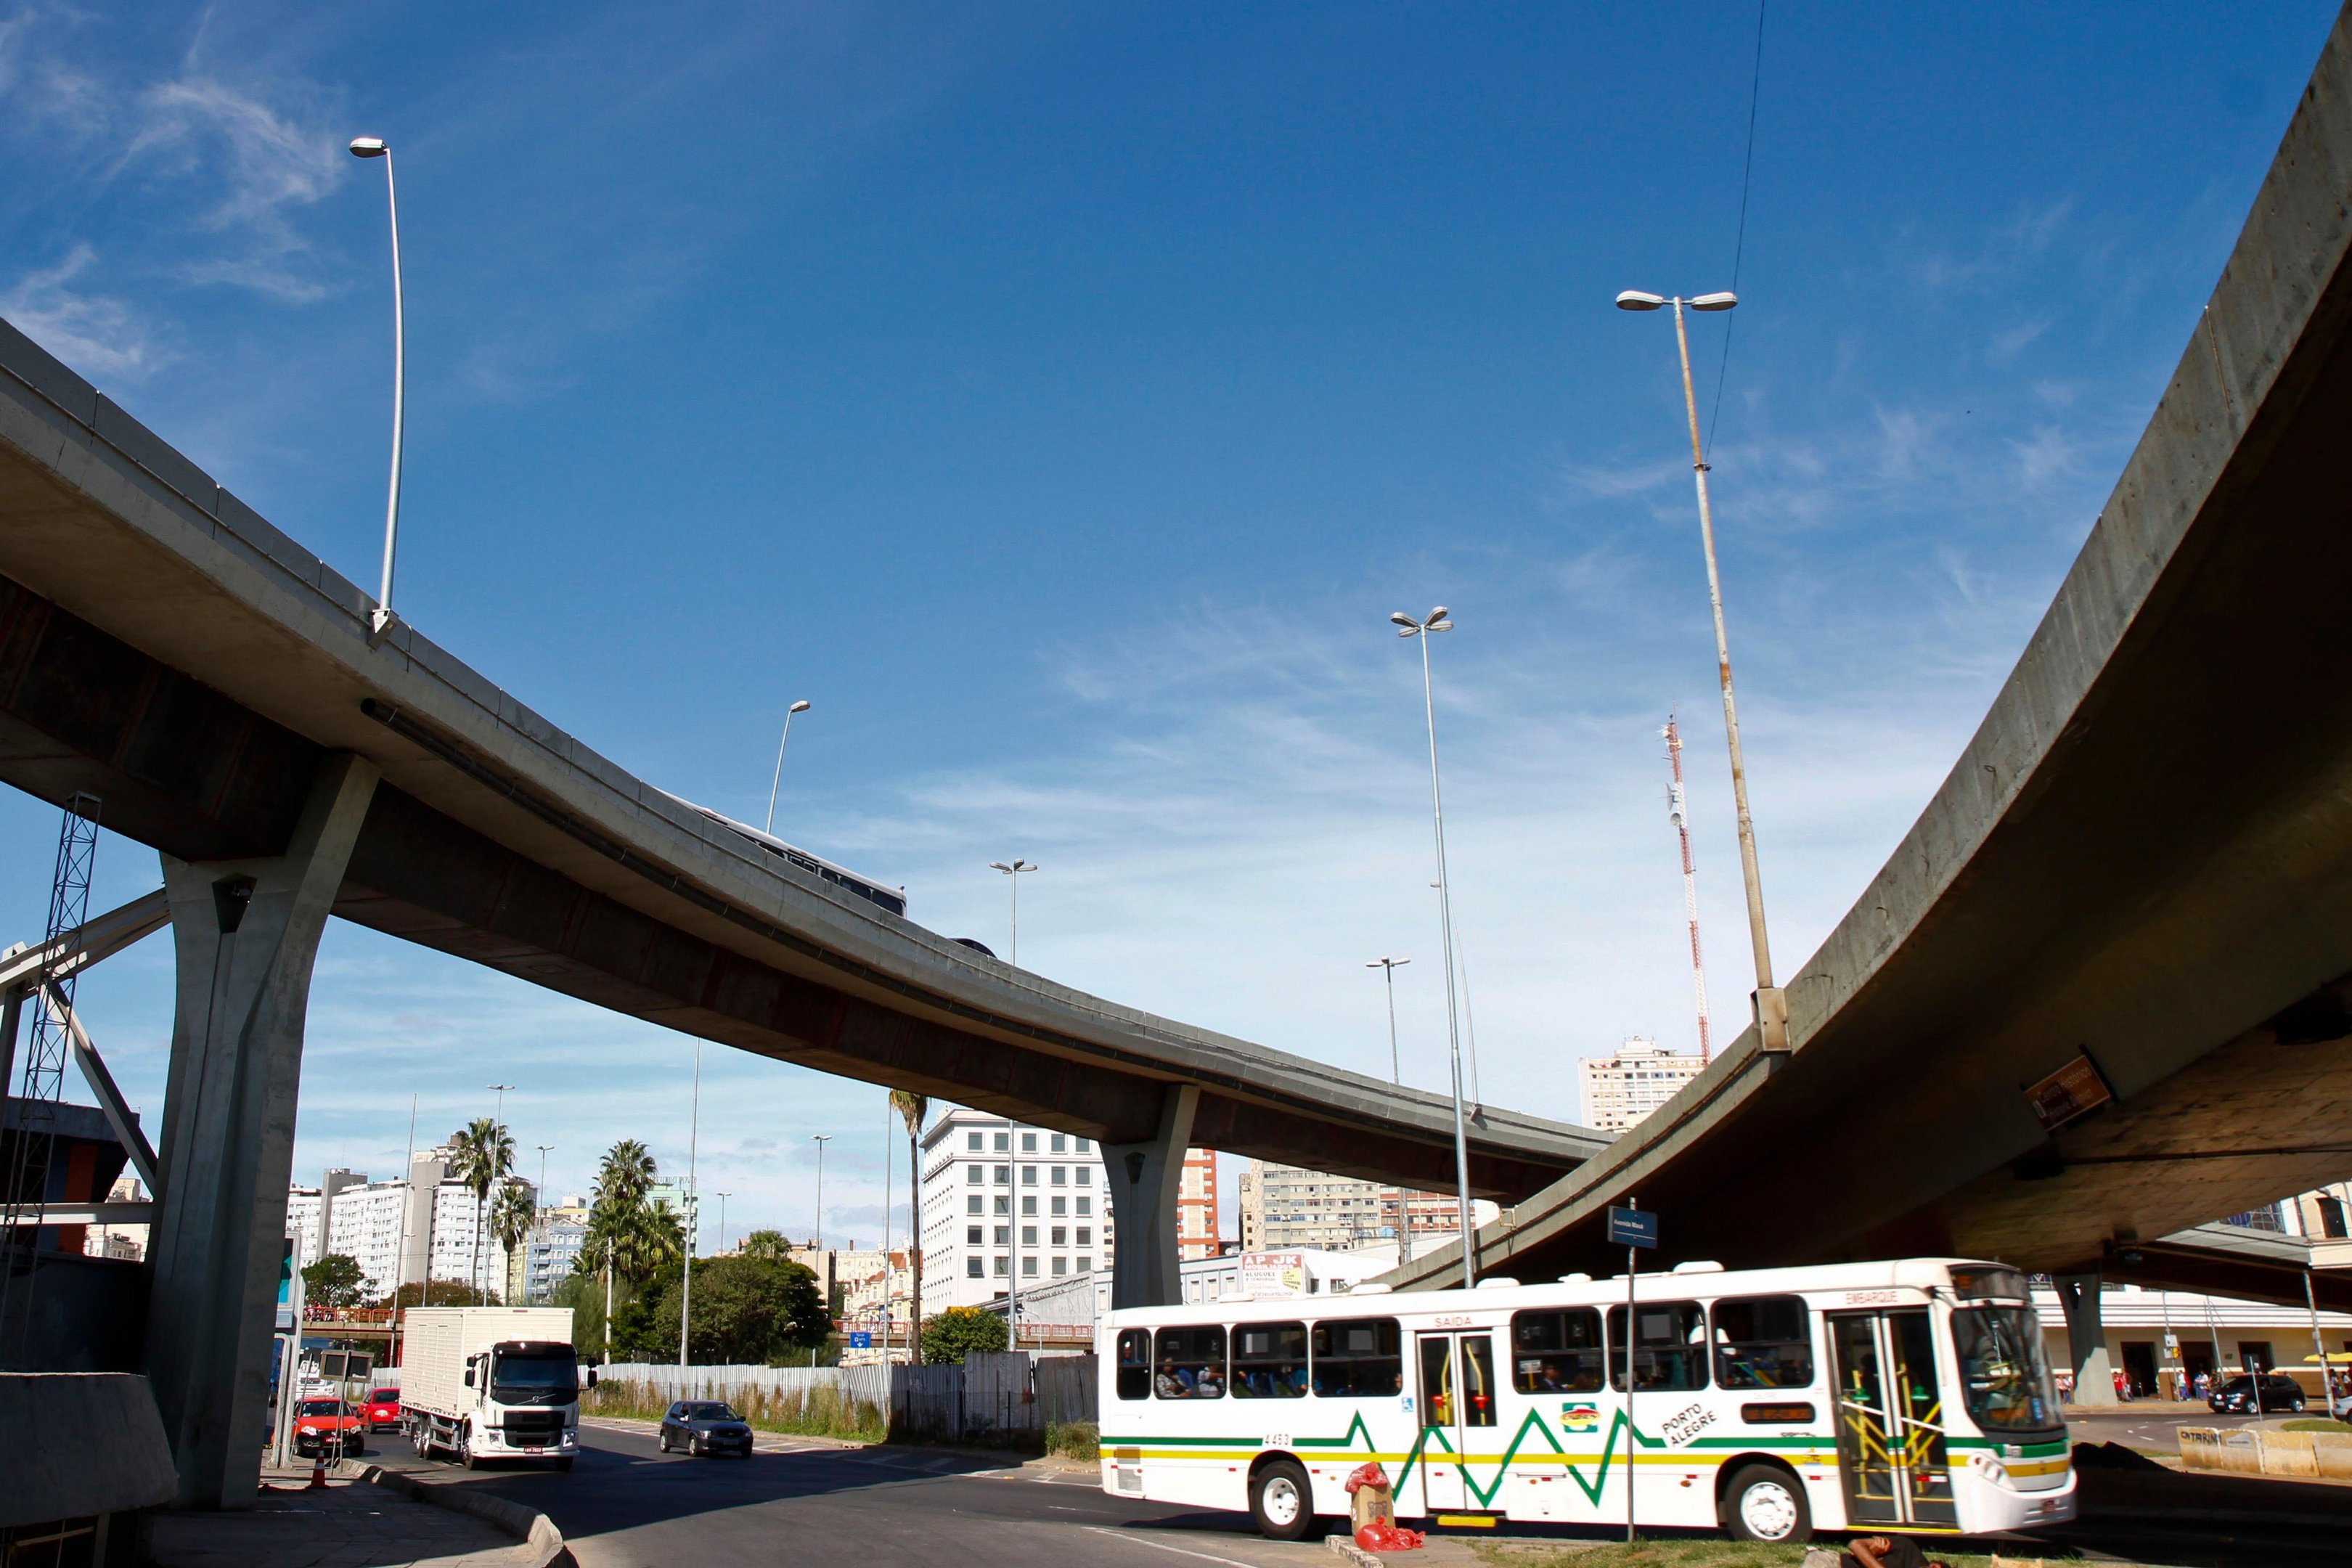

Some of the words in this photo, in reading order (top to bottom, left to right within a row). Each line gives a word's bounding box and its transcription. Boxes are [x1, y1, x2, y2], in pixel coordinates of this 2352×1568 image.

[1244, 1255, 1265, 1264] AP
[1272, 1255, 1298, 1264] JK
[1846, 1291, 1898, 1304] EMBARQUE
[1662, 1403, 1702, 1434] PORTO
[1671, 1410, 1718, 1447] ALEGRE
[1265, 1434, 1290, 1445] 4453
